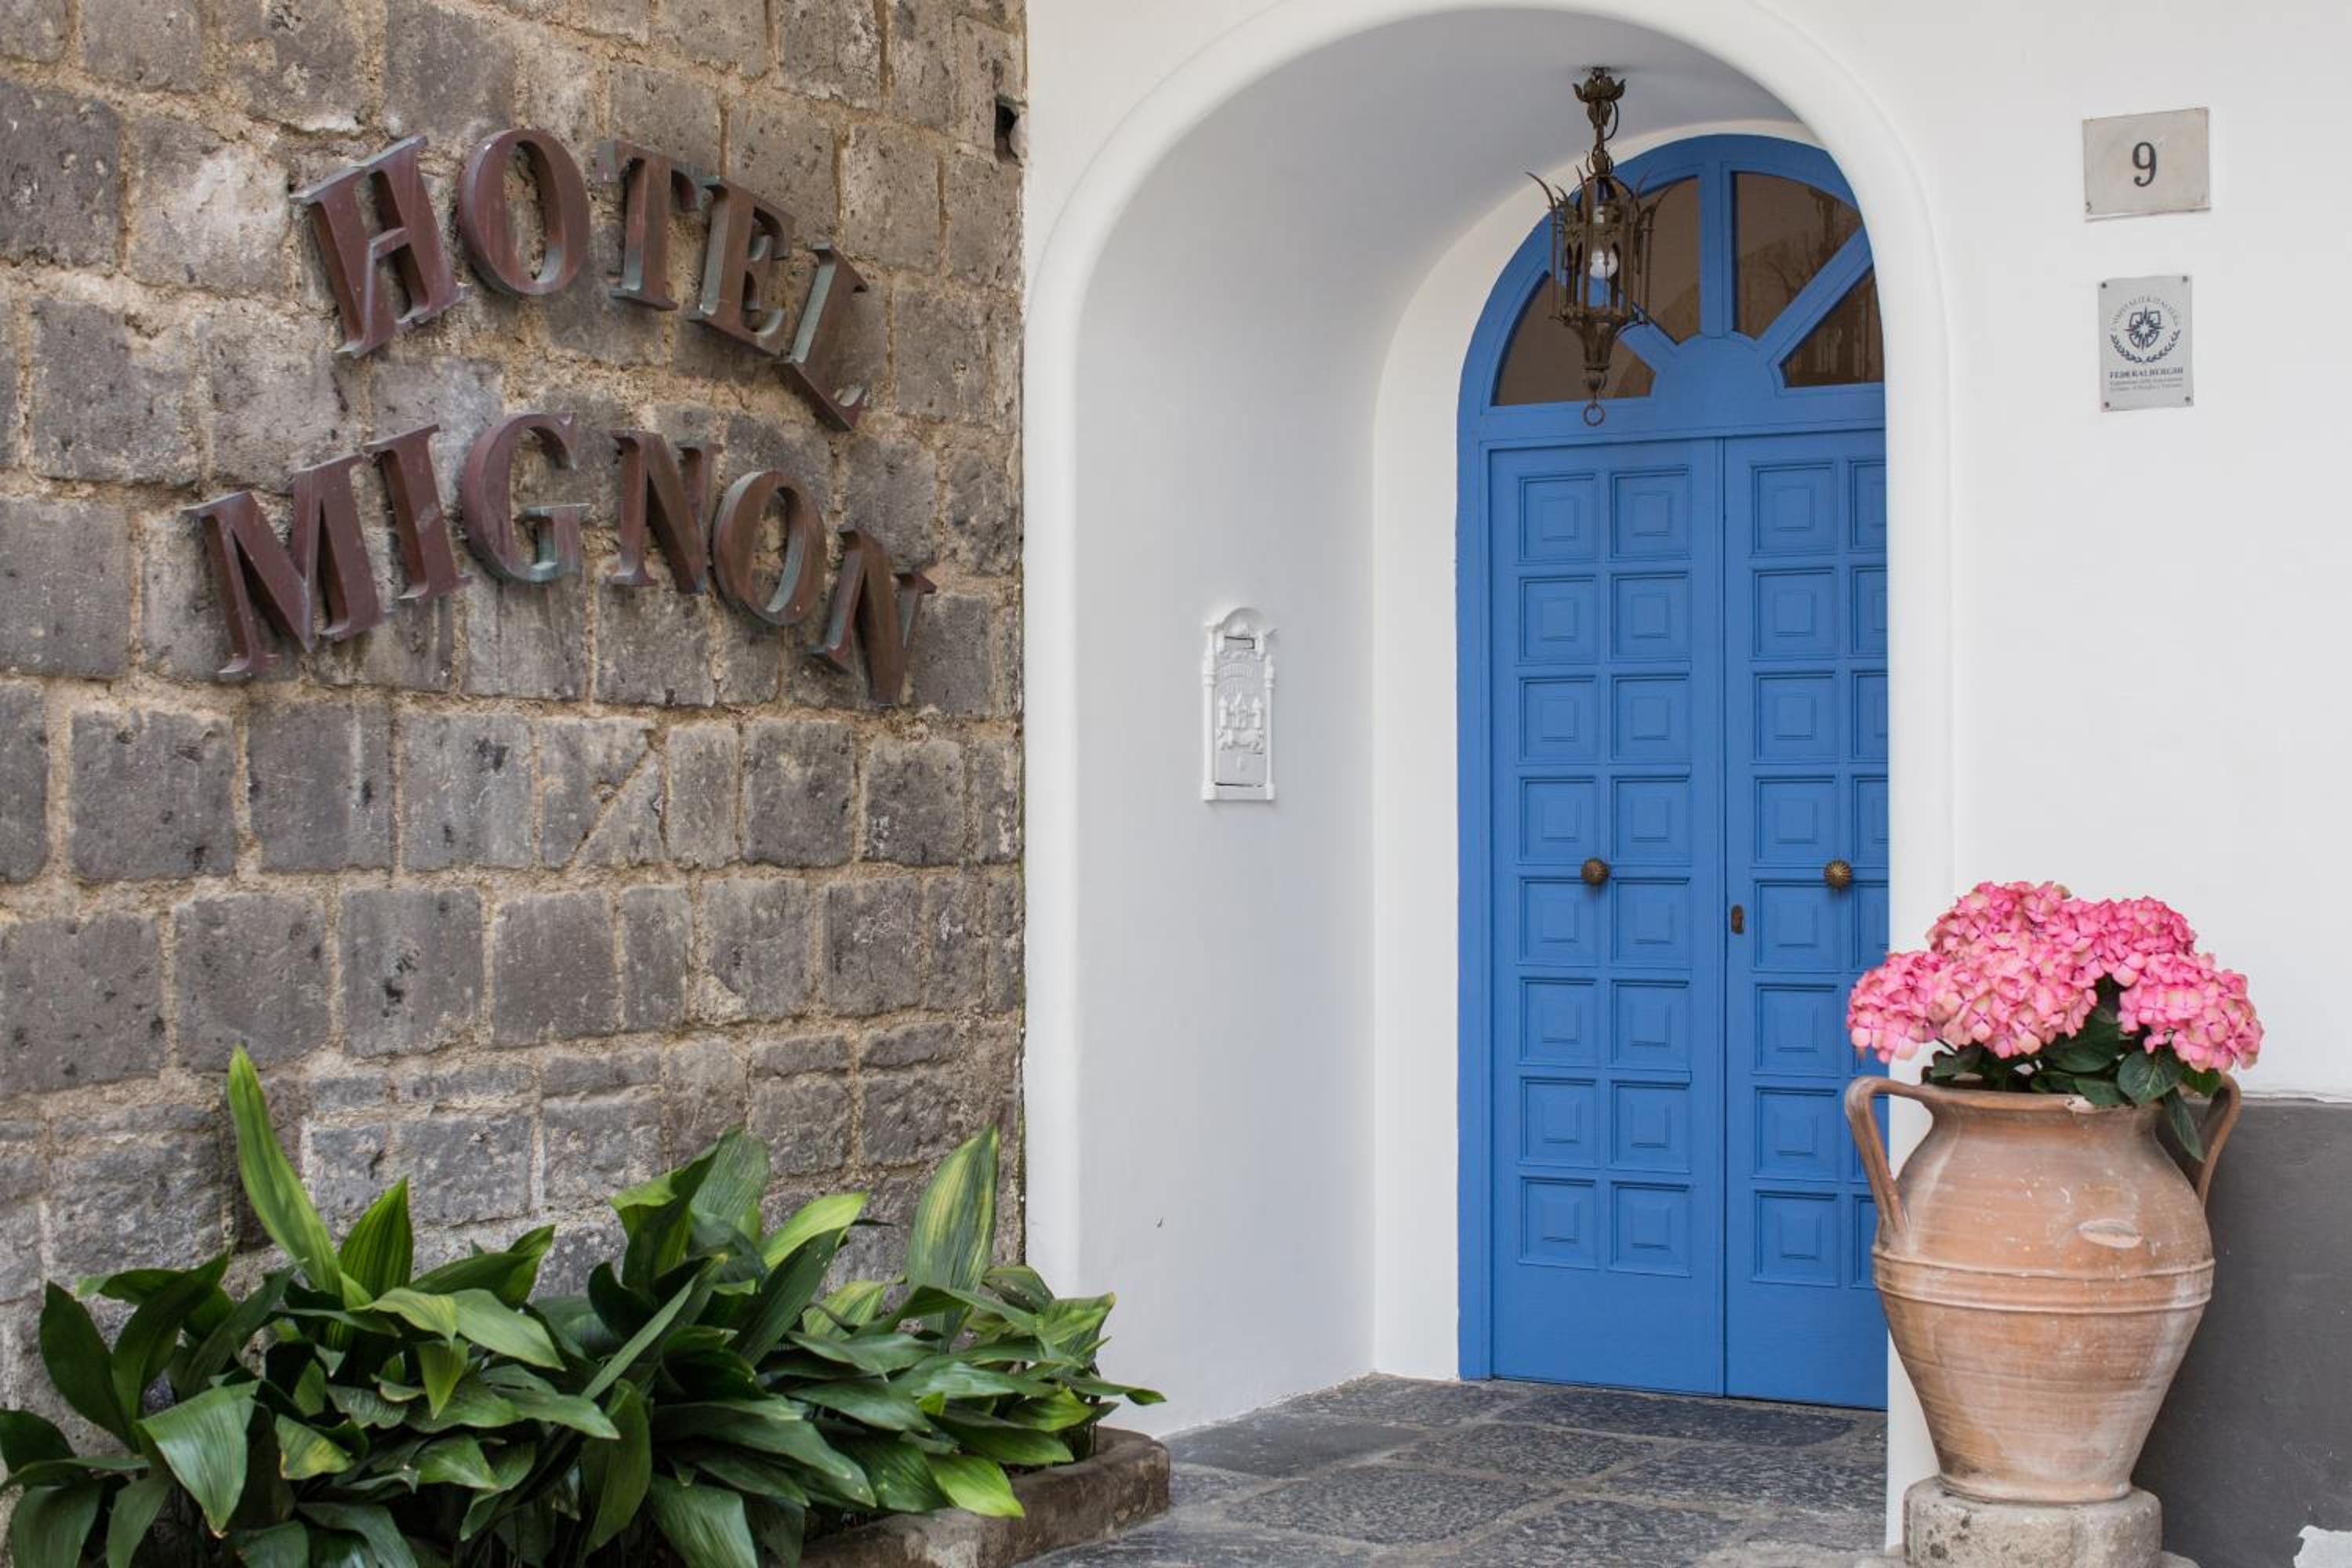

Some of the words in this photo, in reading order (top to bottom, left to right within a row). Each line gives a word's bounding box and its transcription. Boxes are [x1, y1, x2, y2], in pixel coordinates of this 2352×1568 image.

[289, 128, 869, 432] HOTEL
[2132, 141, 2157, 187] 9
[182, 412, 937, 708] MIGNON
